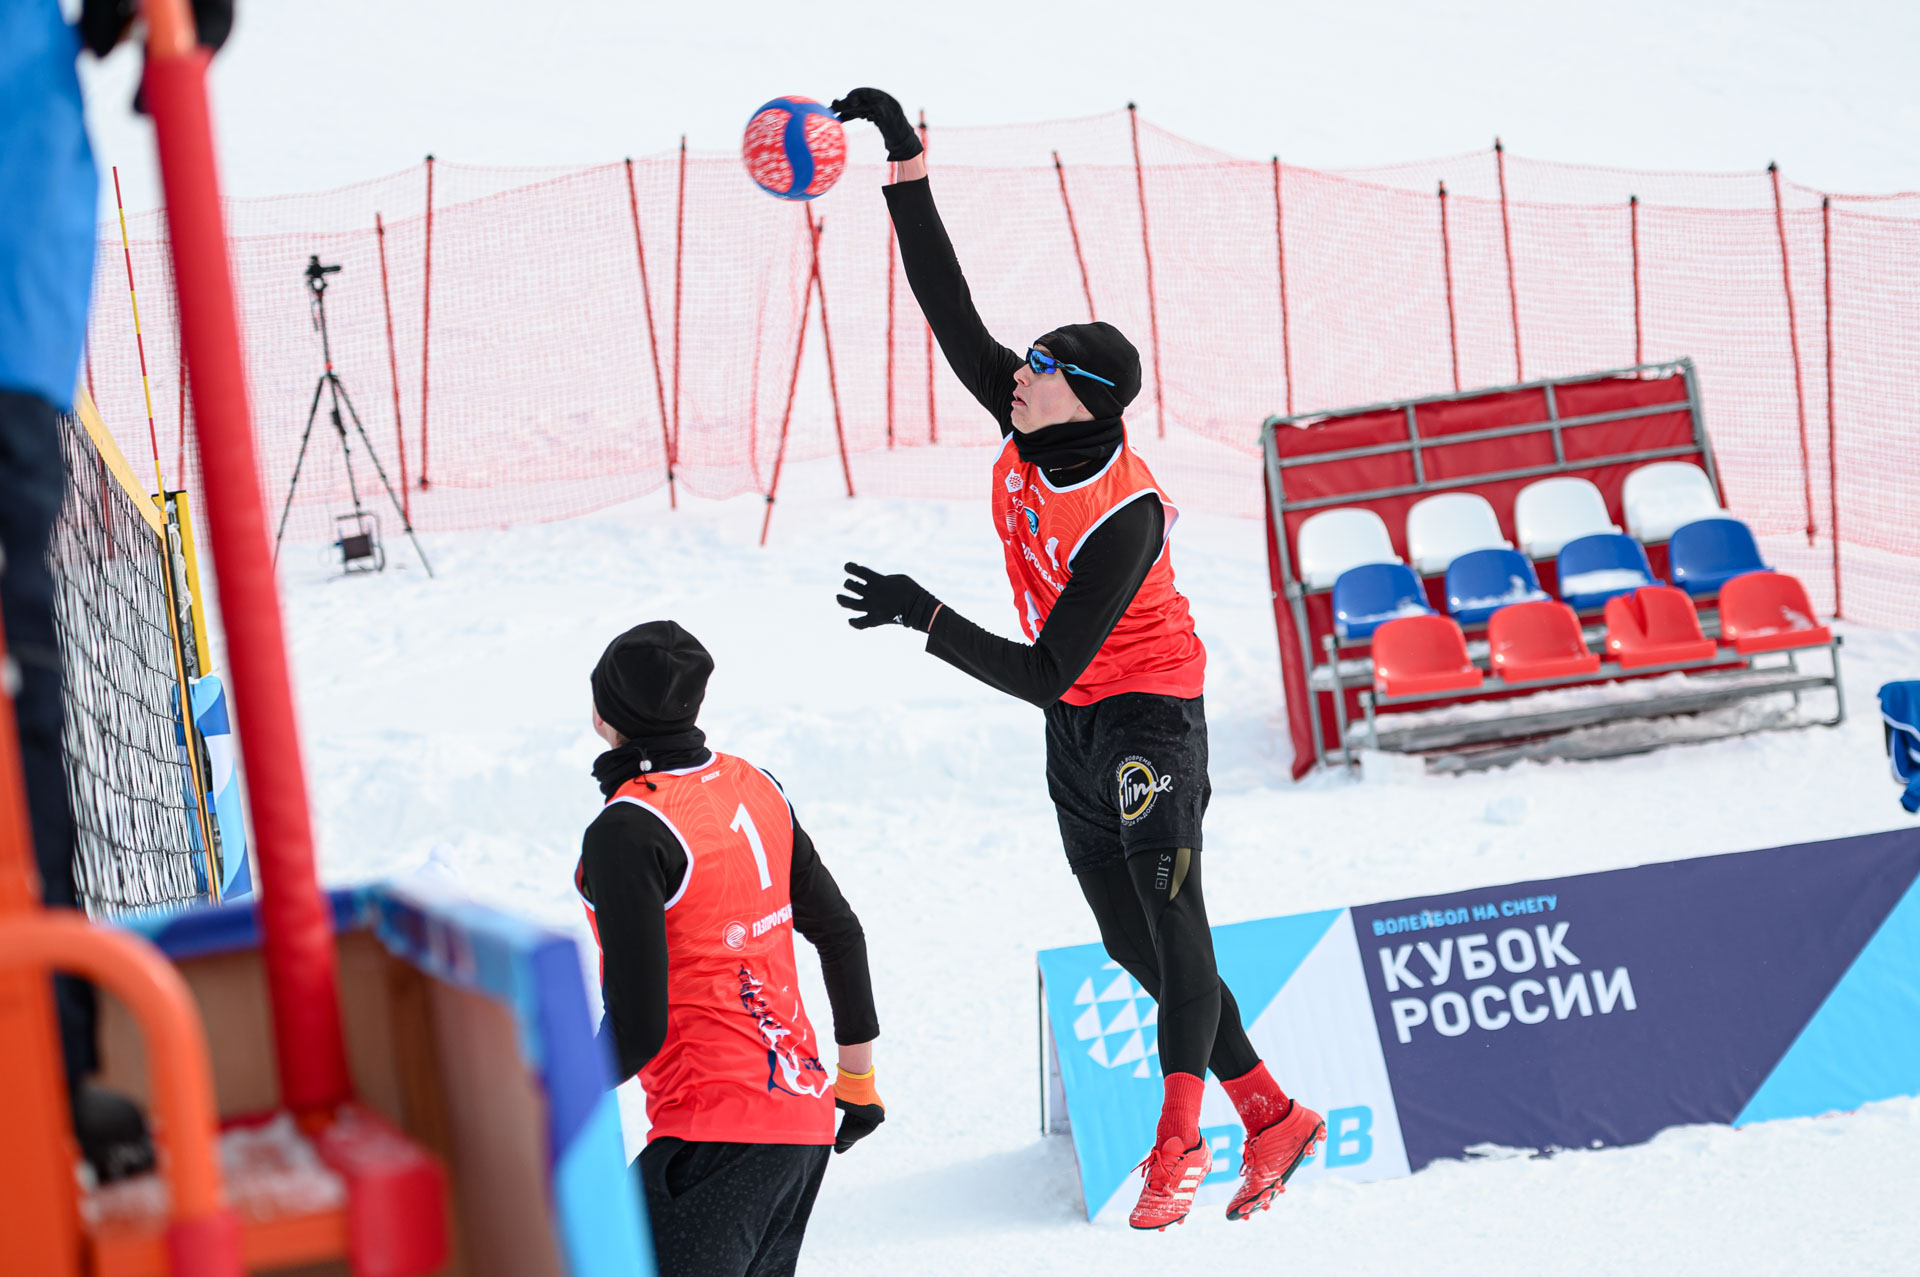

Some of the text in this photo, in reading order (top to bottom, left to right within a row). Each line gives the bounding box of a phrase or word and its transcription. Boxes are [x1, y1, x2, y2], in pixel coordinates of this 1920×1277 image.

[729, 803, 772, 890] 1
[1372, 894, 1558, 936] ВОЛЕЙБОЛ НА СНЕГУ
[1378, 921, 1582, 992] КУБОК
[1390, 966, 1638, 1044] РОССИИ
[1198, 1105, 1374, 1187] ВВ
